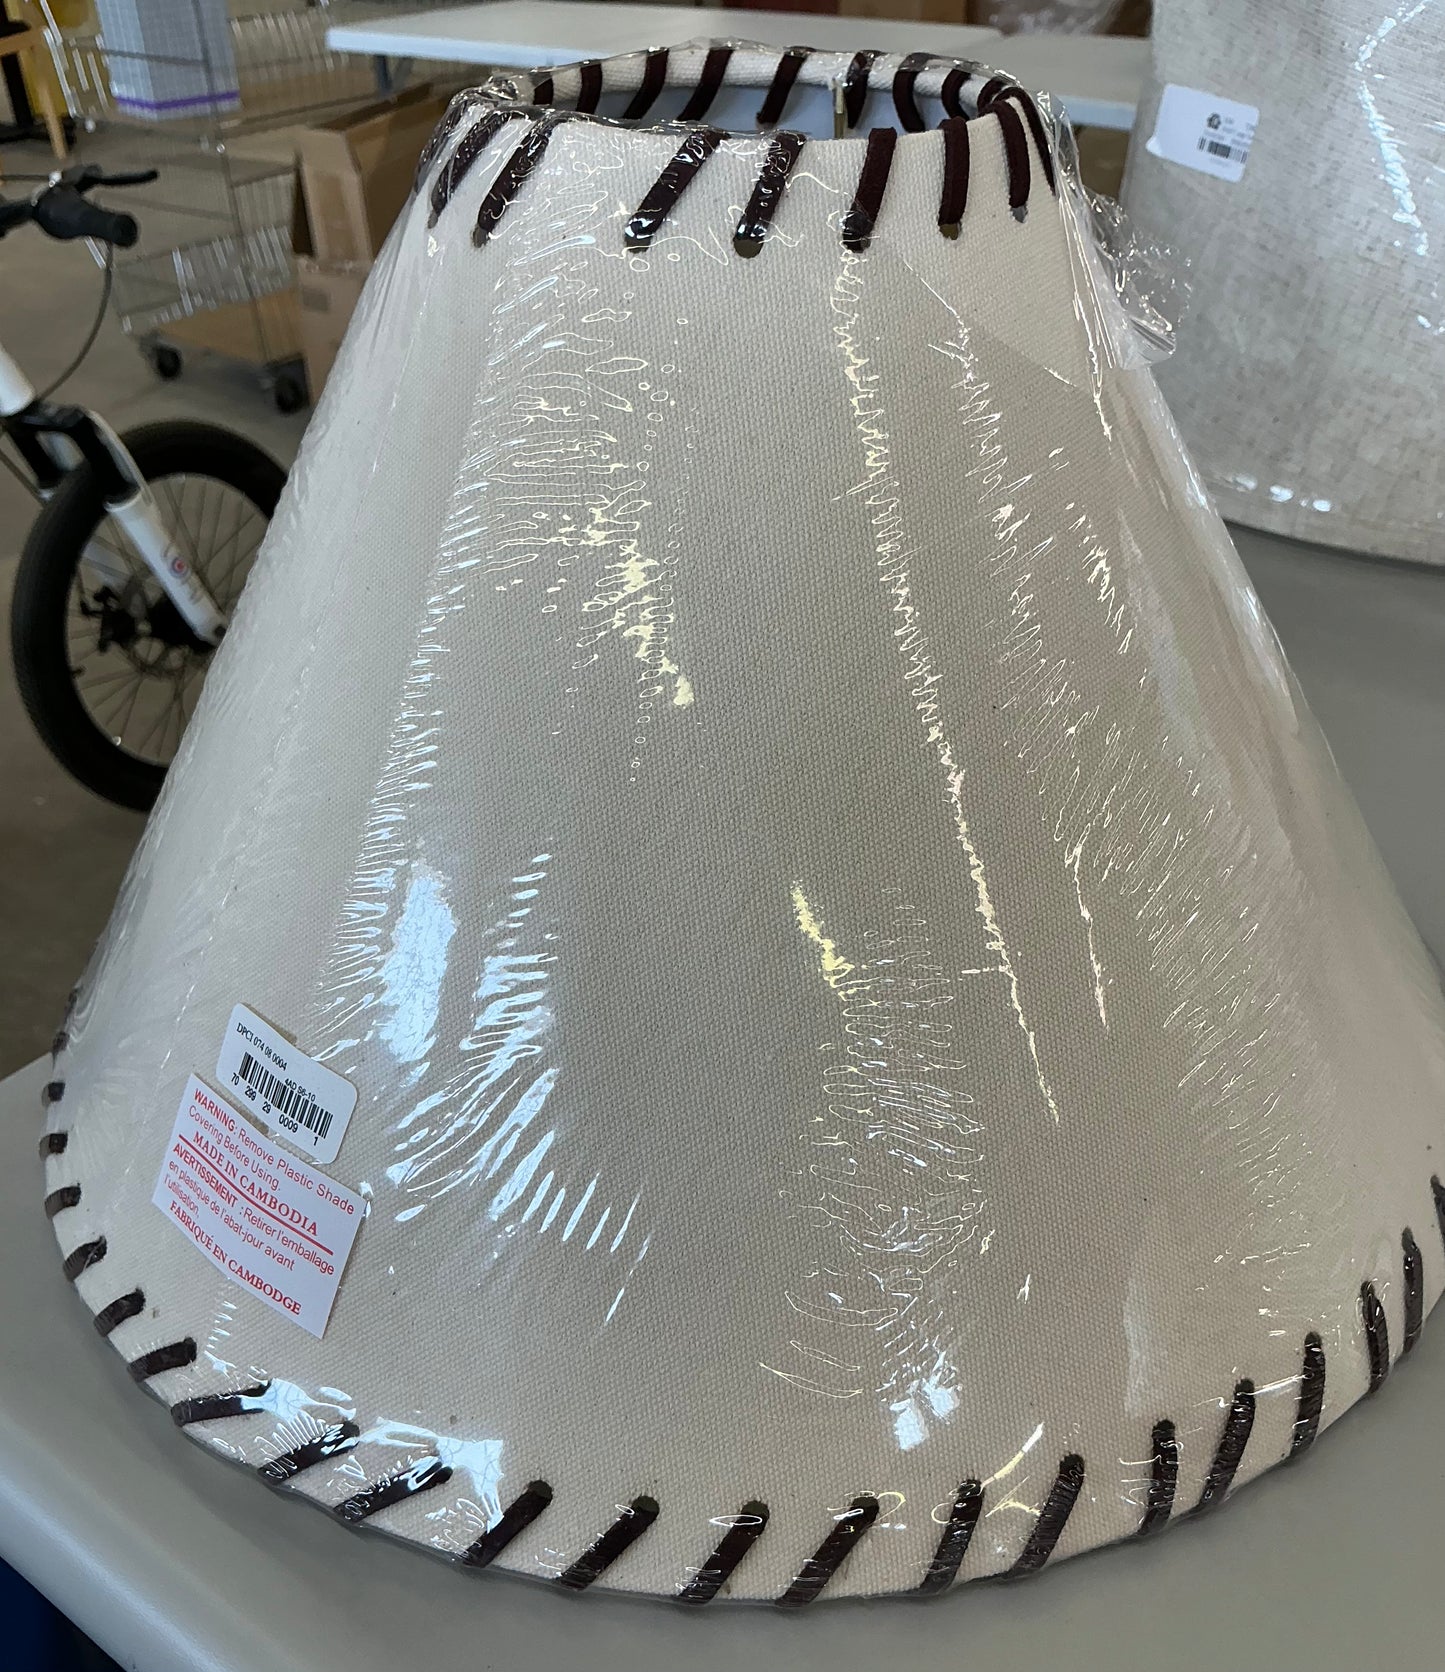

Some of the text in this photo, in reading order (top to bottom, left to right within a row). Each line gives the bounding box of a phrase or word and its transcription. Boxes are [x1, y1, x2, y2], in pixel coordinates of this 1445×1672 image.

[237, 1022, 287, 1071] DPCI 074 08 0004
[285, 1078, 297, 1090] 4AD
[189, 1105, 280, 1191] Covering Before Using.
[194, 1088, 354, 1215] WARNING: Remove Plastic Shade
[231, 1072, 319, 1146] 70 299 29 0009 1
[169, 1161, 295, 1271] en plastique de l'abat-jour avant
[173, 1143, 238, 1208] AVERTISSEMENT
[277, 1229, 335, 1275] l'emballage
[193, 1131, 318, 1236] MADE IN CAMBODIA
[170, 1200, 302, 1315] FABRIQUÉ EN CAMBODGE
